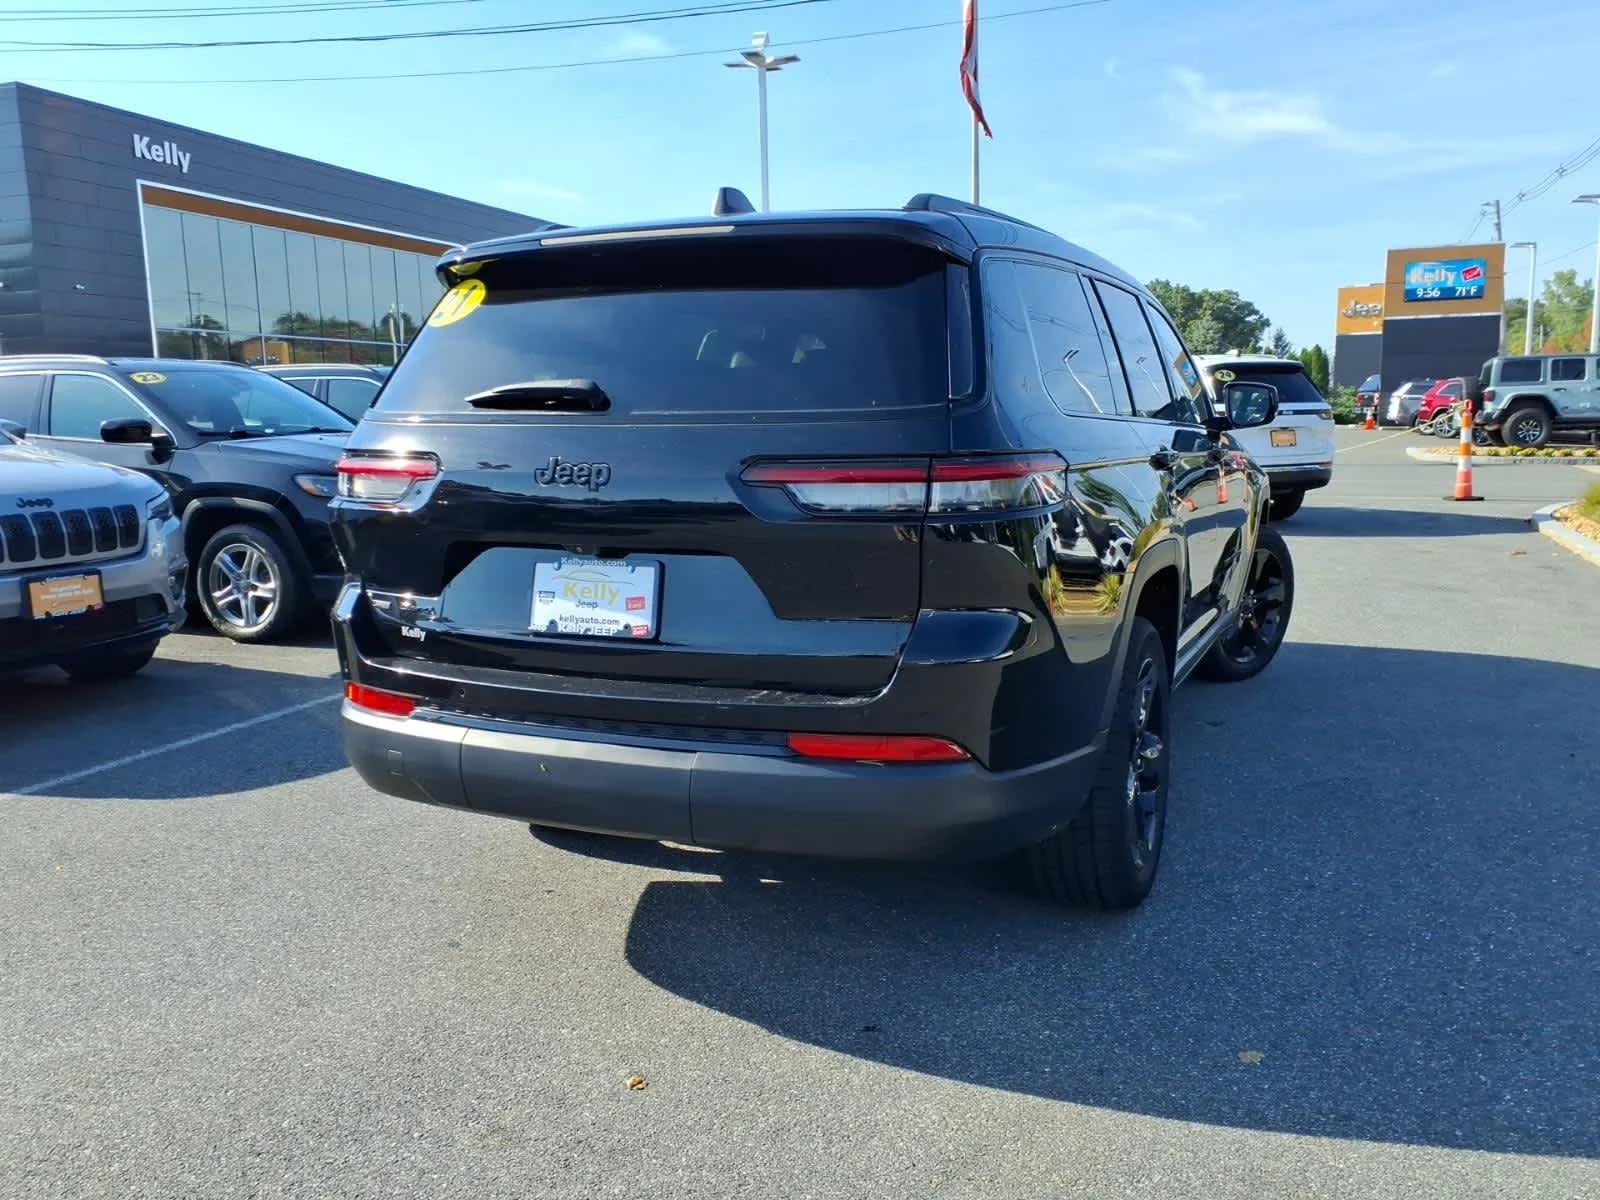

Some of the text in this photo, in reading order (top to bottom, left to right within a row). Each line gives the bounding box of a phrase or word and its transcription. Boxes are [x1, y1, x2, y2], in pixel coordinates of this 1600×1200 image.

[133, 133, 191, 173] Kelly
[1416, 287, 1440, 298] 9:56
[1343, 299, 1383, 318] Jee
[535, 456, 612, 493] Jeep
[563, 581, 619, 606] Kelly
[575, 599, 599, 610] Jeep
[559, 613, 621, 626] kellyauto.com
[401, 625, 426, 642] Kelly
